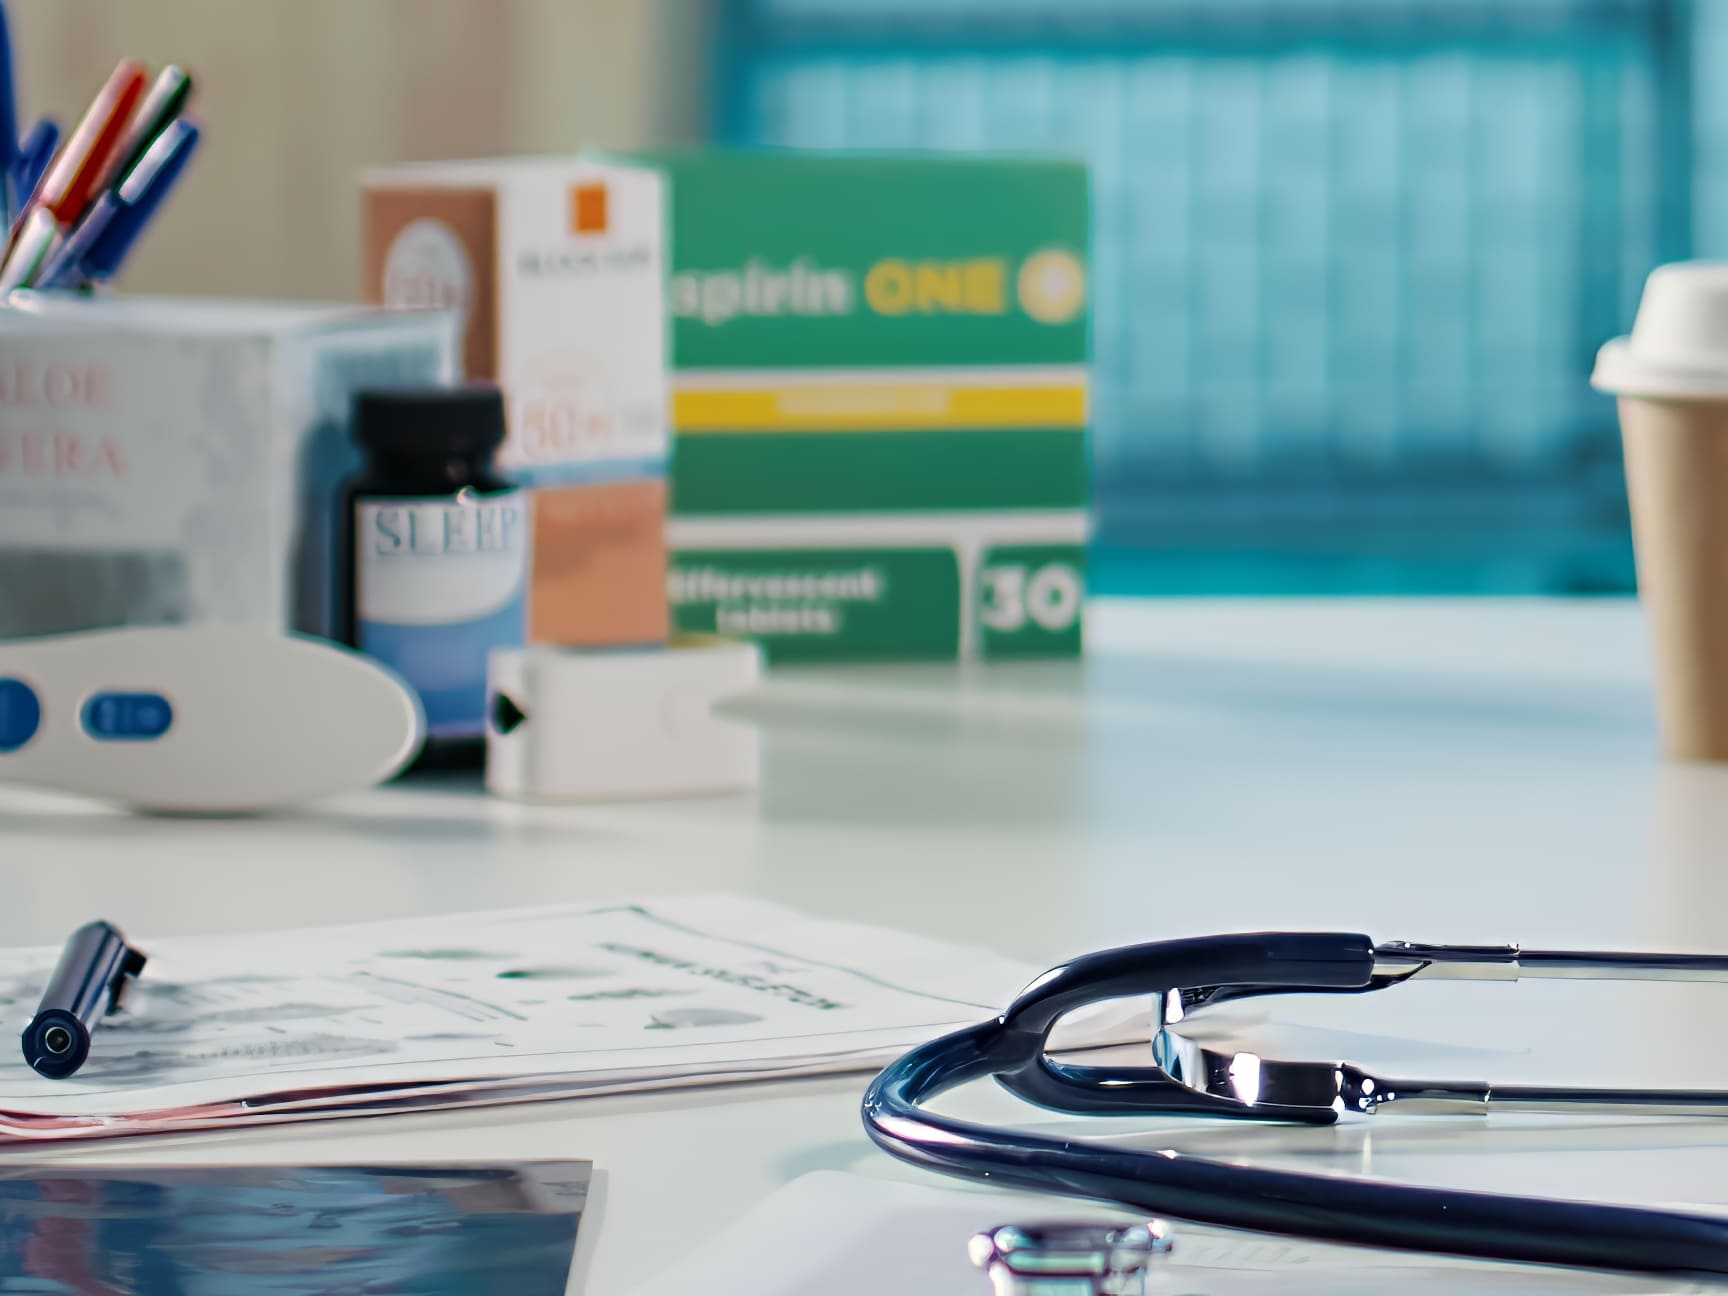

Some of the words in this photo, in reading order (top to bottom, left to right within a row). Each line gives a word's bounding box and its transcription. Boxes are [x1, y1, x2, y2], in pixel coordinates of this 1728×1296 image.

[671, 256, 854, 327] spirin
[865, 256, 1008, 316] ONE
[375, 509, 518, 558] SLEEP
[981, 564, 1082, 633] 30
